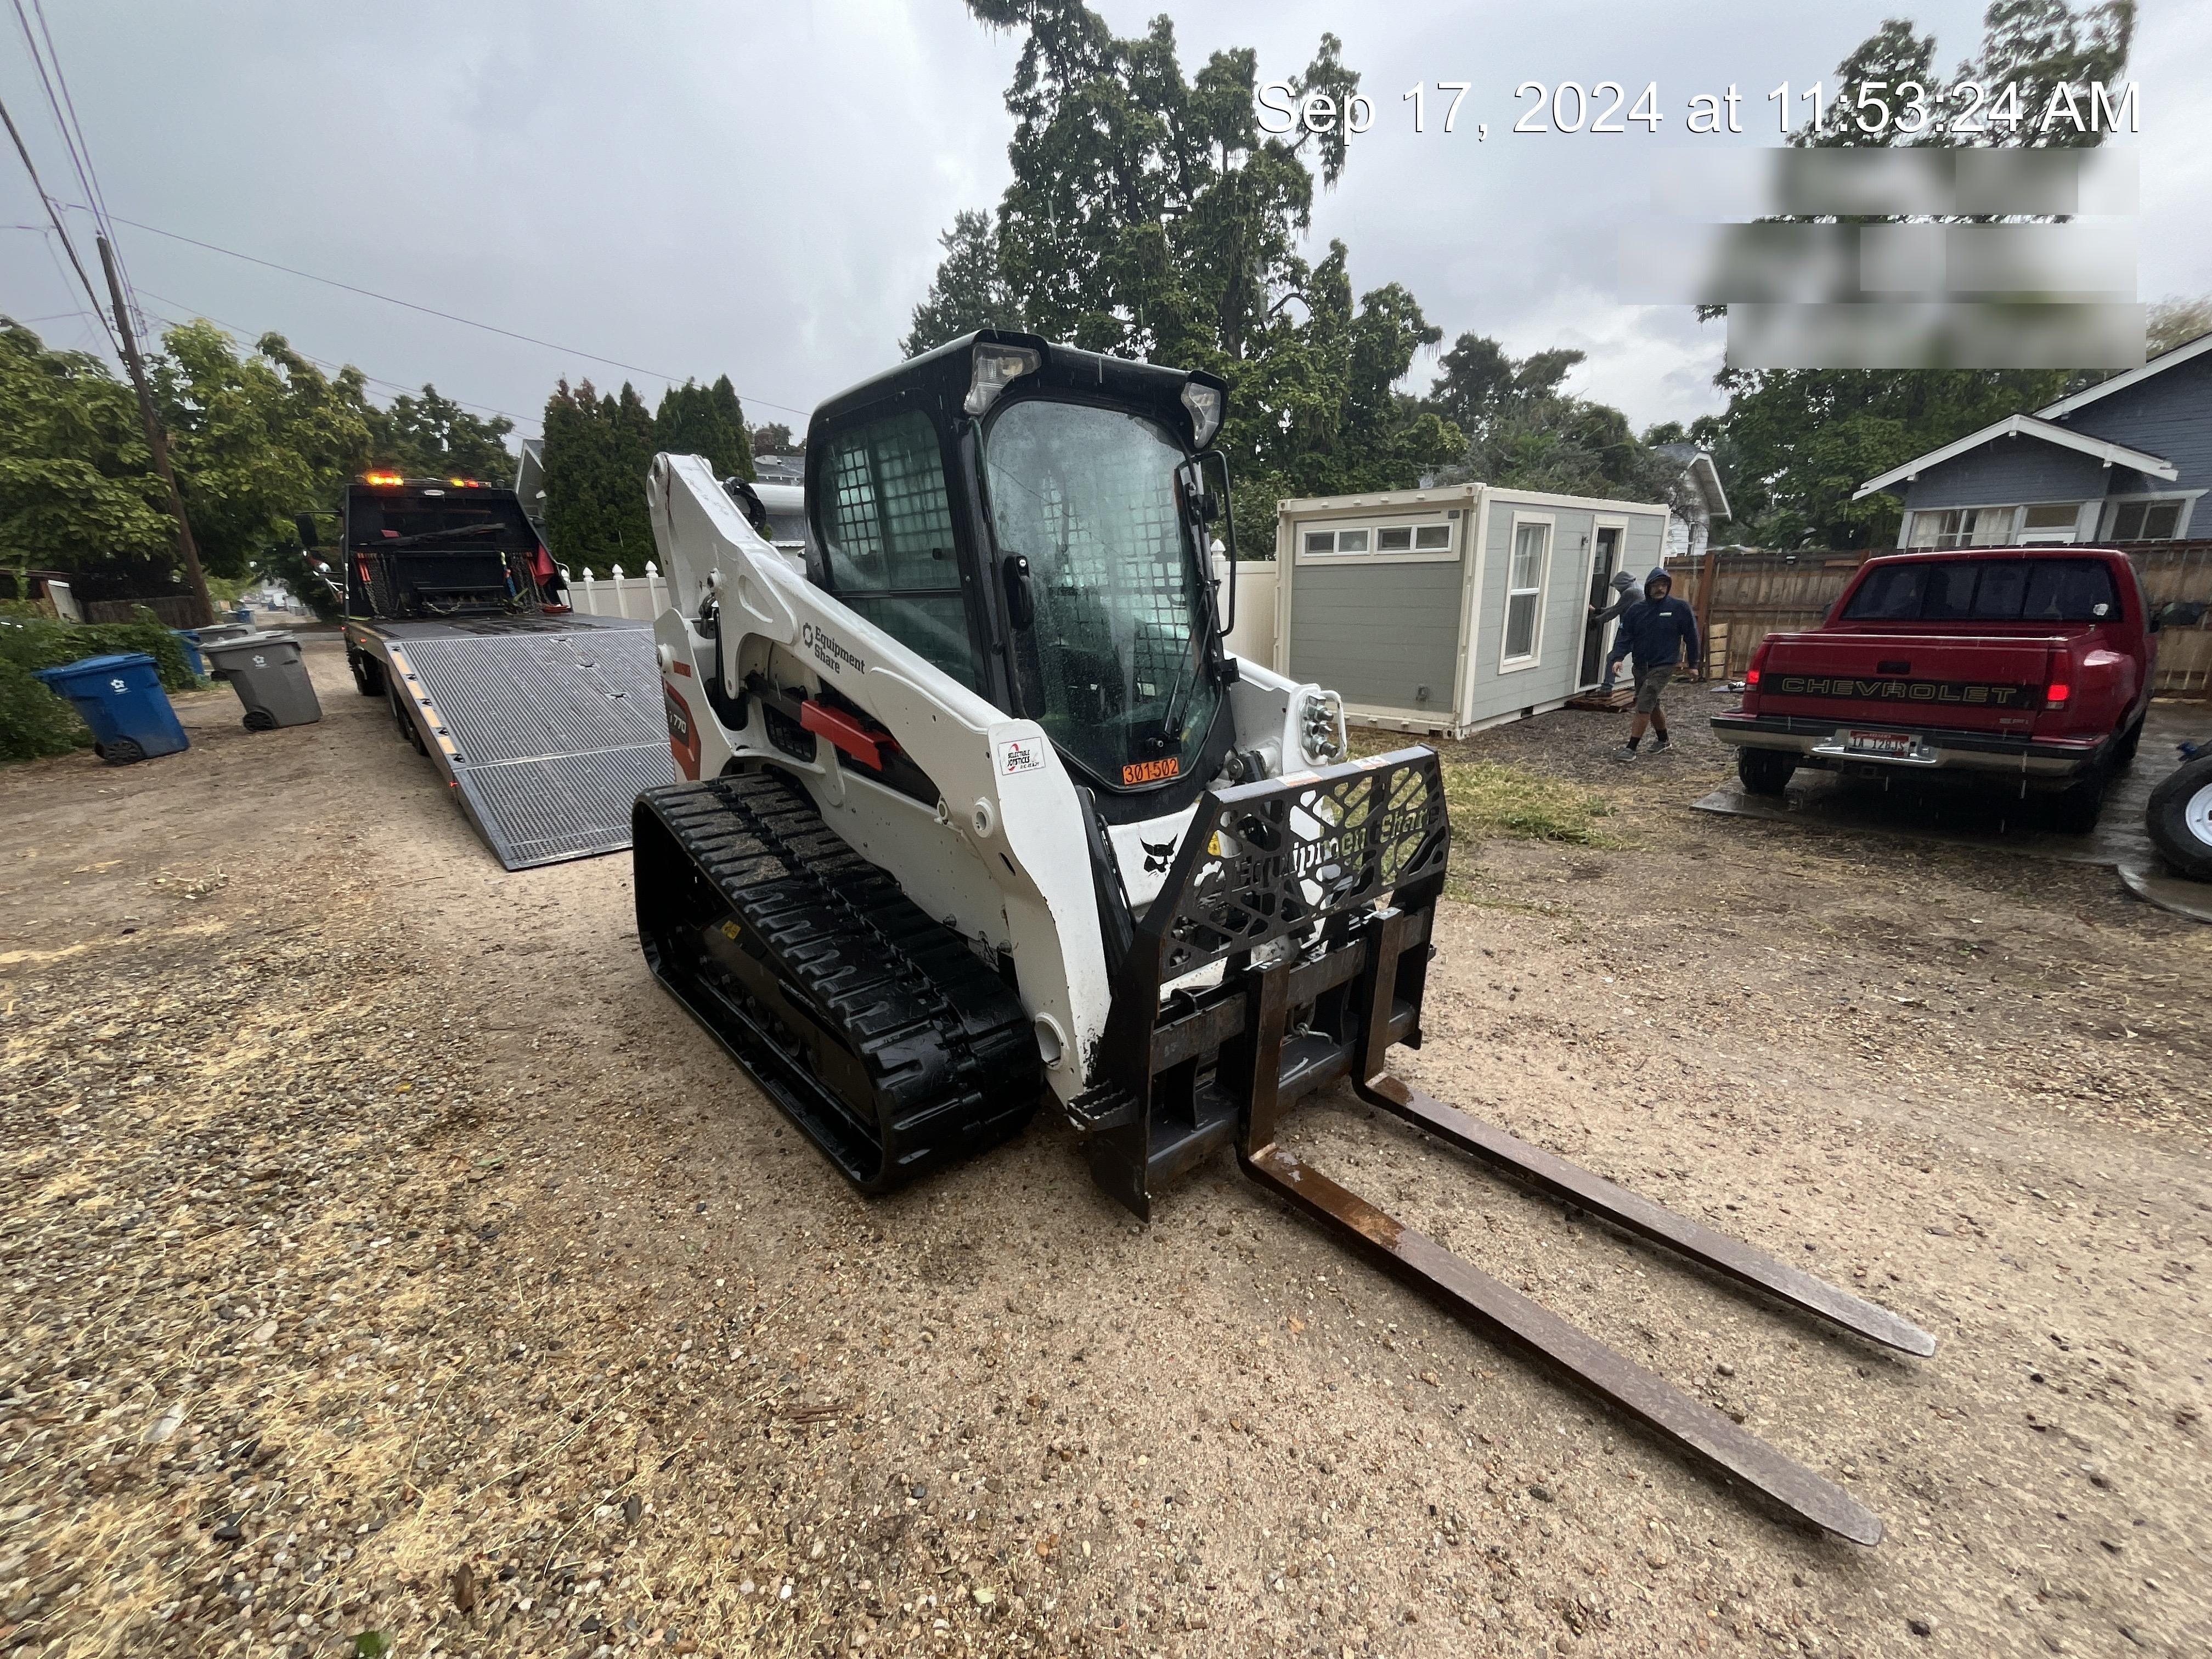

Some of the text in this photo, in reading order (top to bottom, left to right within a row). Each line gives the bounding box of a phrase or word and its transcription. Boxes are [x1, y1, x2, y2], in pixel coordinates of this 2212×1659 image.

[815, 626, 865, 675] Equipment
[815, 644, 840, 674] Share
[1781, 678, 2017, 703] CHEVROLET
